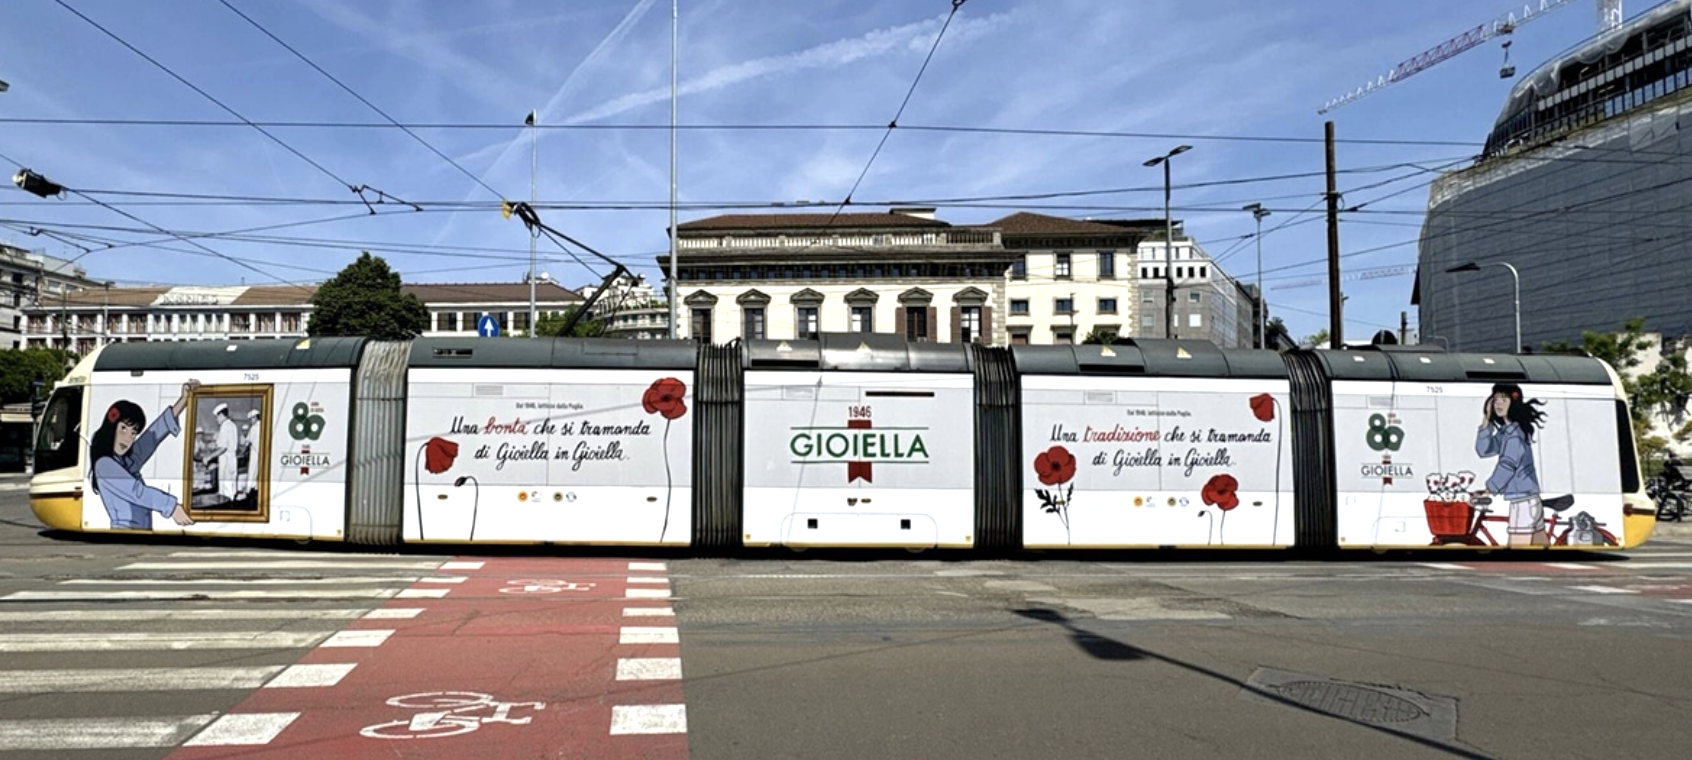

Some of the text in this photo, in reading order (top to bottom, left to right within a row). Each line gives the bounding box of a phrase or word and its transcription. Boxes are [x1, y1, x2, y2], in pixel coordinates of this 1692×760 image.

[243, 372, 260, 381] 7525
[848, 405, 872, 418] 1946
[449, 417, 479, 435] Una
[533, 417, 557, 435] che
[561, 420, 575, 436] si
[580, 419, 652, 435] tramanda
[1050, 424, 1272, 443] Una tradizione che si tramanda
[790, 433, 930, 458] GIOIELLA
[280, 455, 330, 466] GIOIELLA
[474, 444, 491, 459] di
[495, 442, 549, 470] Gioiella
[554, 445, 569, 459] in
[1092, 451, 1107, 466] di
[1112, 448, 1162, 476] Gioiella
[1167, 452, 1182, 466] in
[1361, 465, 1413, 477] GIOIELLA
